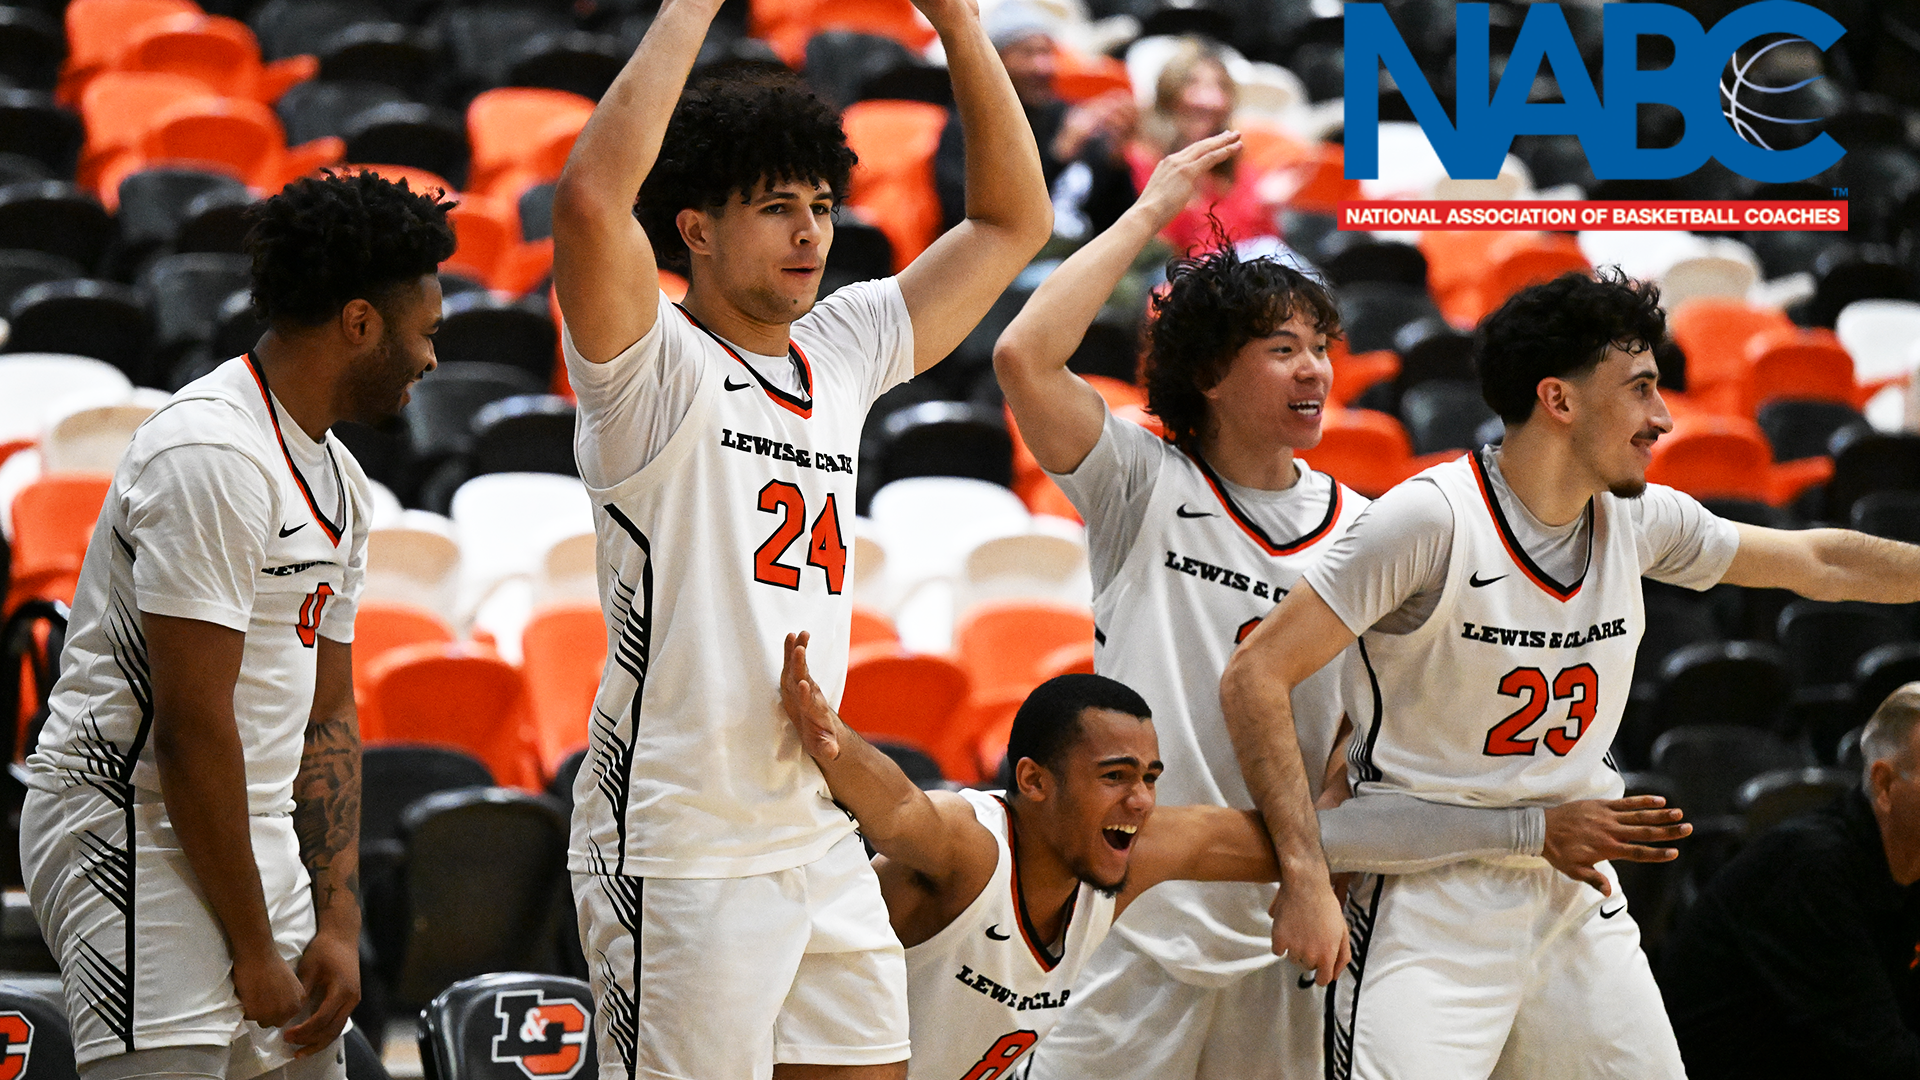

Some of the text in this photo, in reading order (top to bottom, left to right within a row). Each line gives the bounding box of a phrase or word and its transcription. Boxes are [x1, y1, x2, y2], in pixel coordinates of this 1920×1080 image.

[721, 428, 796, 462] LEWIS
[754, 478, 847, 596] 24
[1164, 550, 1251, 592] LEWIS
[1253, 581, 1269, 600] &
[1461, 618, 1627, 649] LEWIS & CLARK
[1482, 662, 1599, 757] 23
